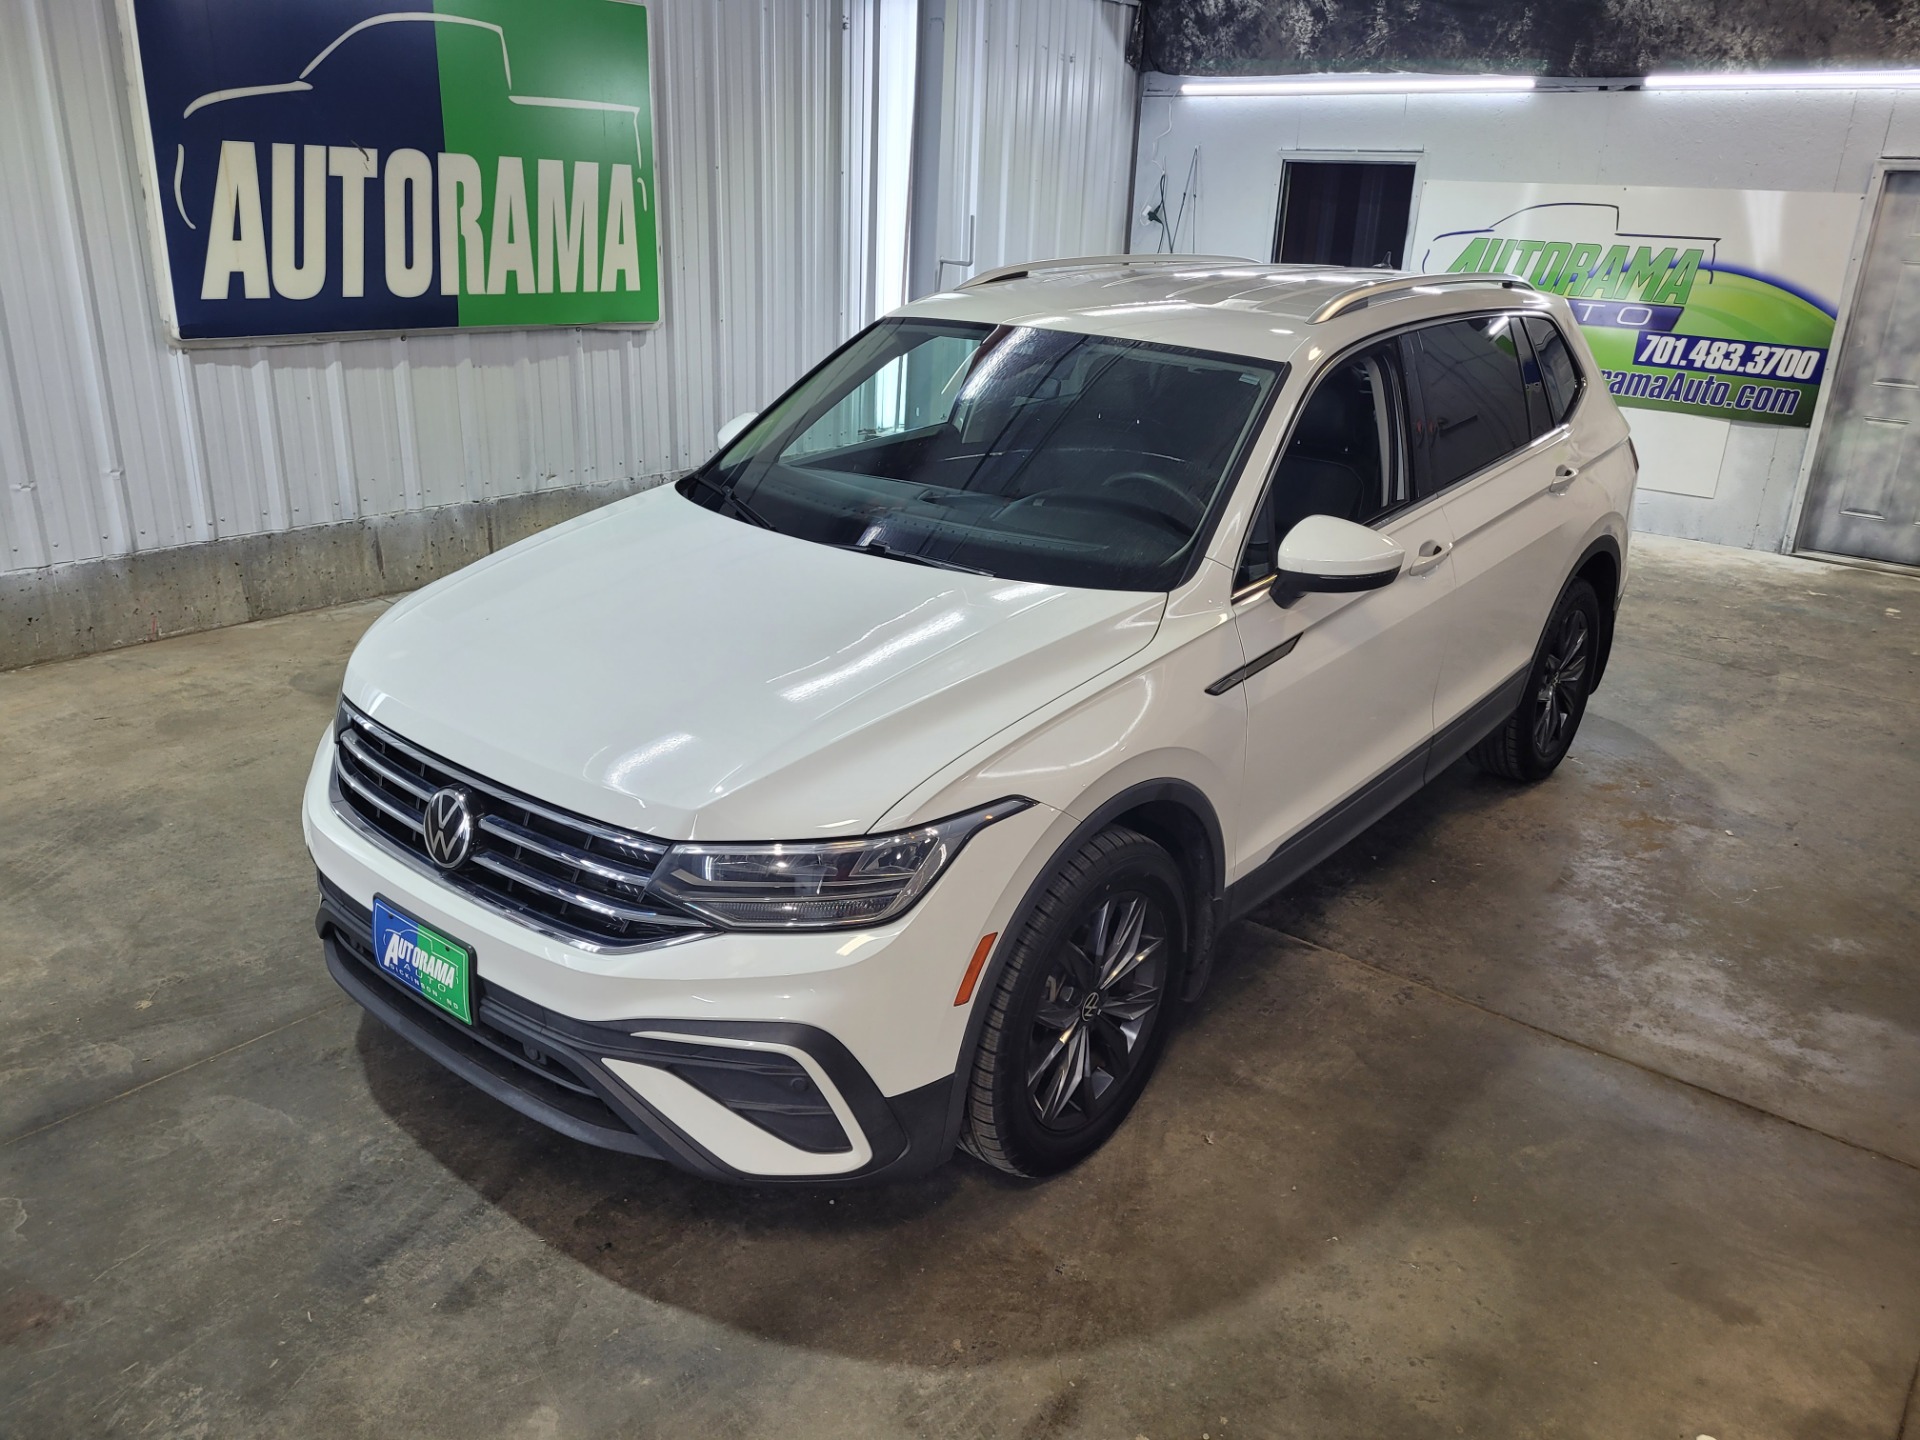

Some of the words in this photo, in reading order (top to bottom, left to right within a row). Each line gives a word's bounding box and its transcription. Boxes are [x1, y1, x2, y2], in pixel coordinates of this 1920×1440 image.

[200, 139, 641, 299] AUTORAMA
[1445, 237, 1704, 304] AUTORAMA
[1578, 302, 1652, 326] TO
[1638, 334, 1821, 380] 701.483.3700
[1600, 369, 1801, 415] ramaAuto.com
[383, 933, 456, 989] AUTORAMA
[403, 963, 446, 992] AUTO
